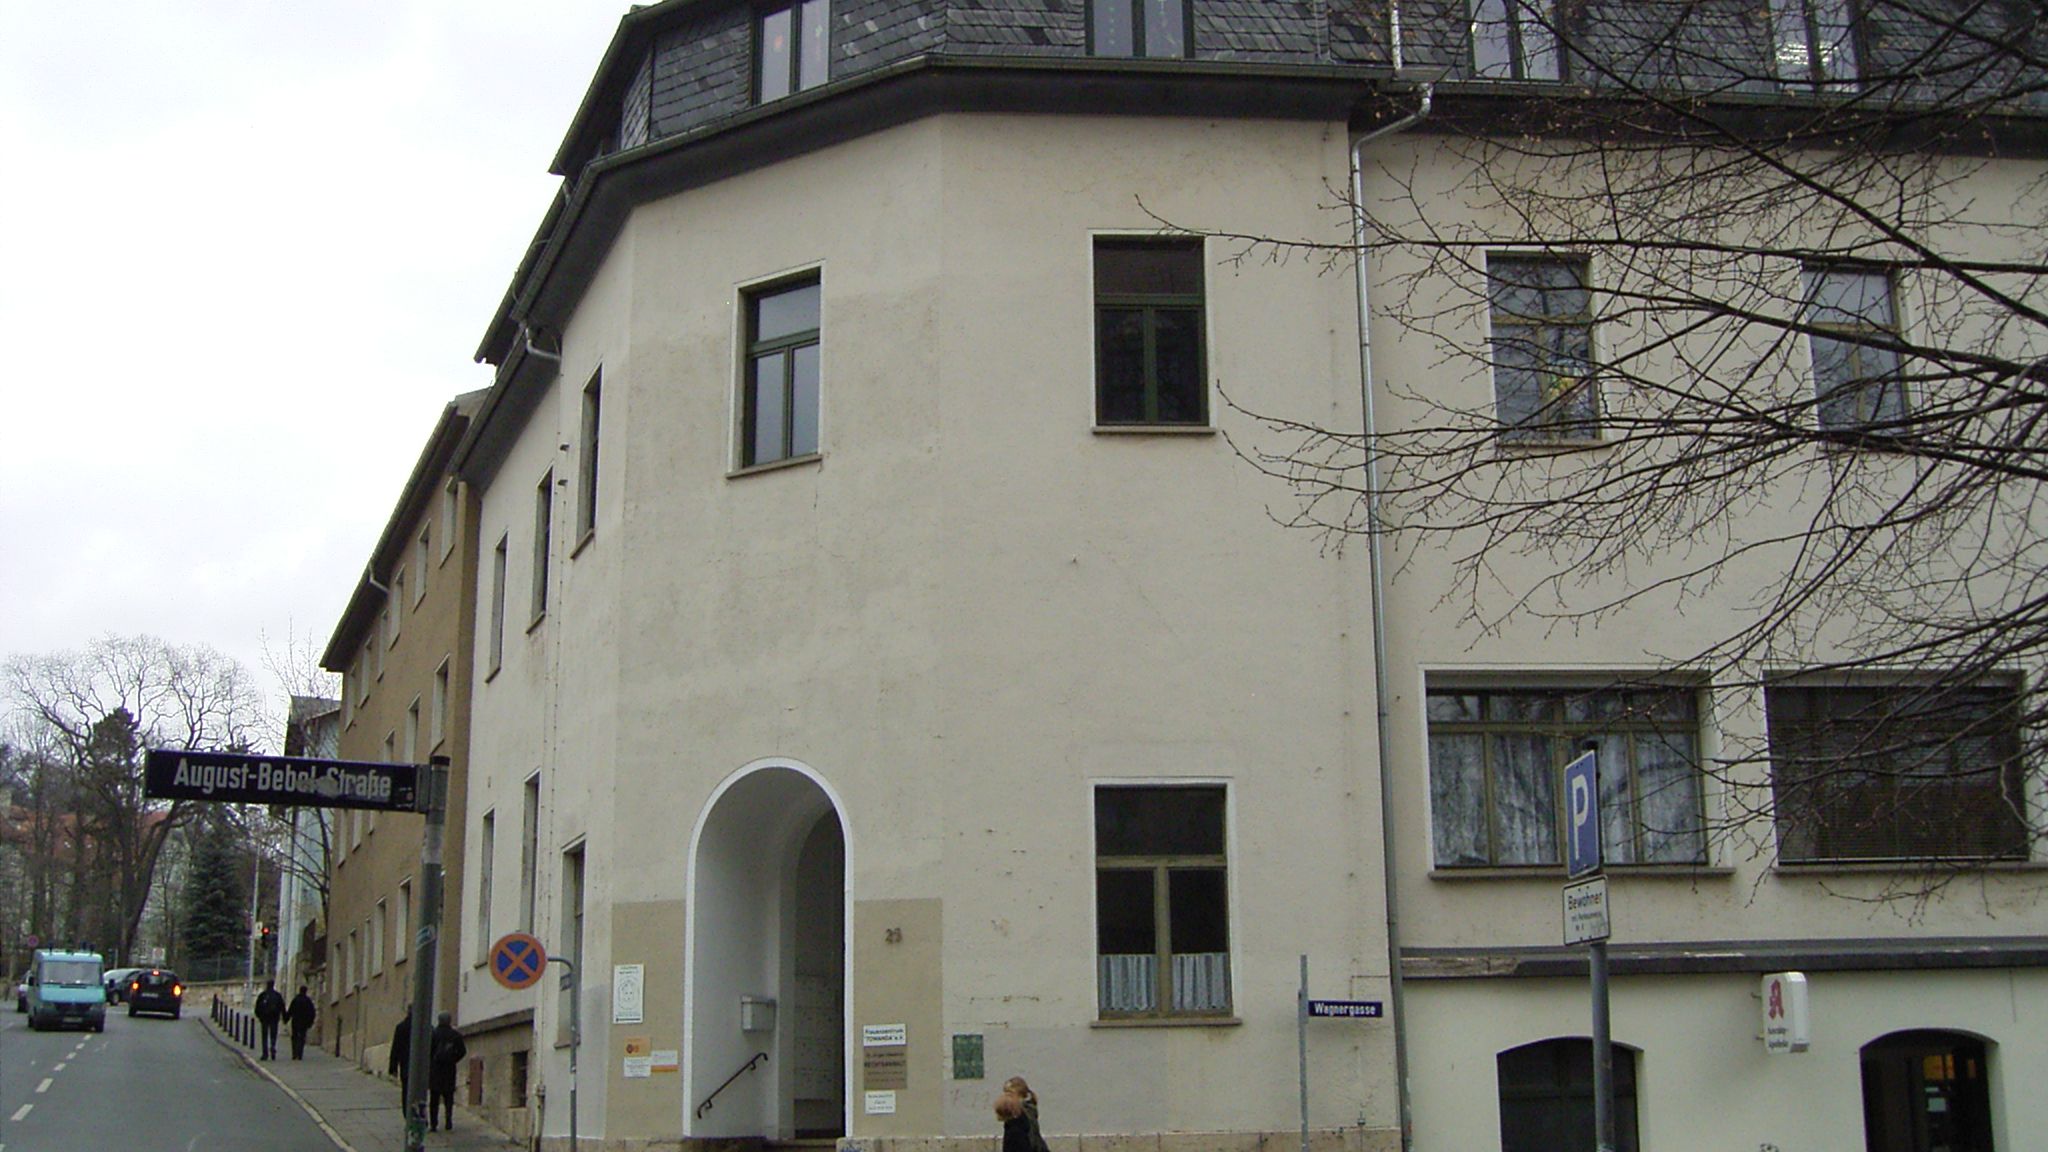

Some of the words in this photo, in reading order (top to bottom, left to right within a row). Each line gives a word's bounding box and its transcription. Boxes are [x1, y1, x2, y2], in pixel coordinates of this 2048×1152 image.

[1572, 774, 1589, 861] P
[1568, 892, 1602, 910] Bewohner
[1314, 1002, 1376, 1016] Wagnergasse
